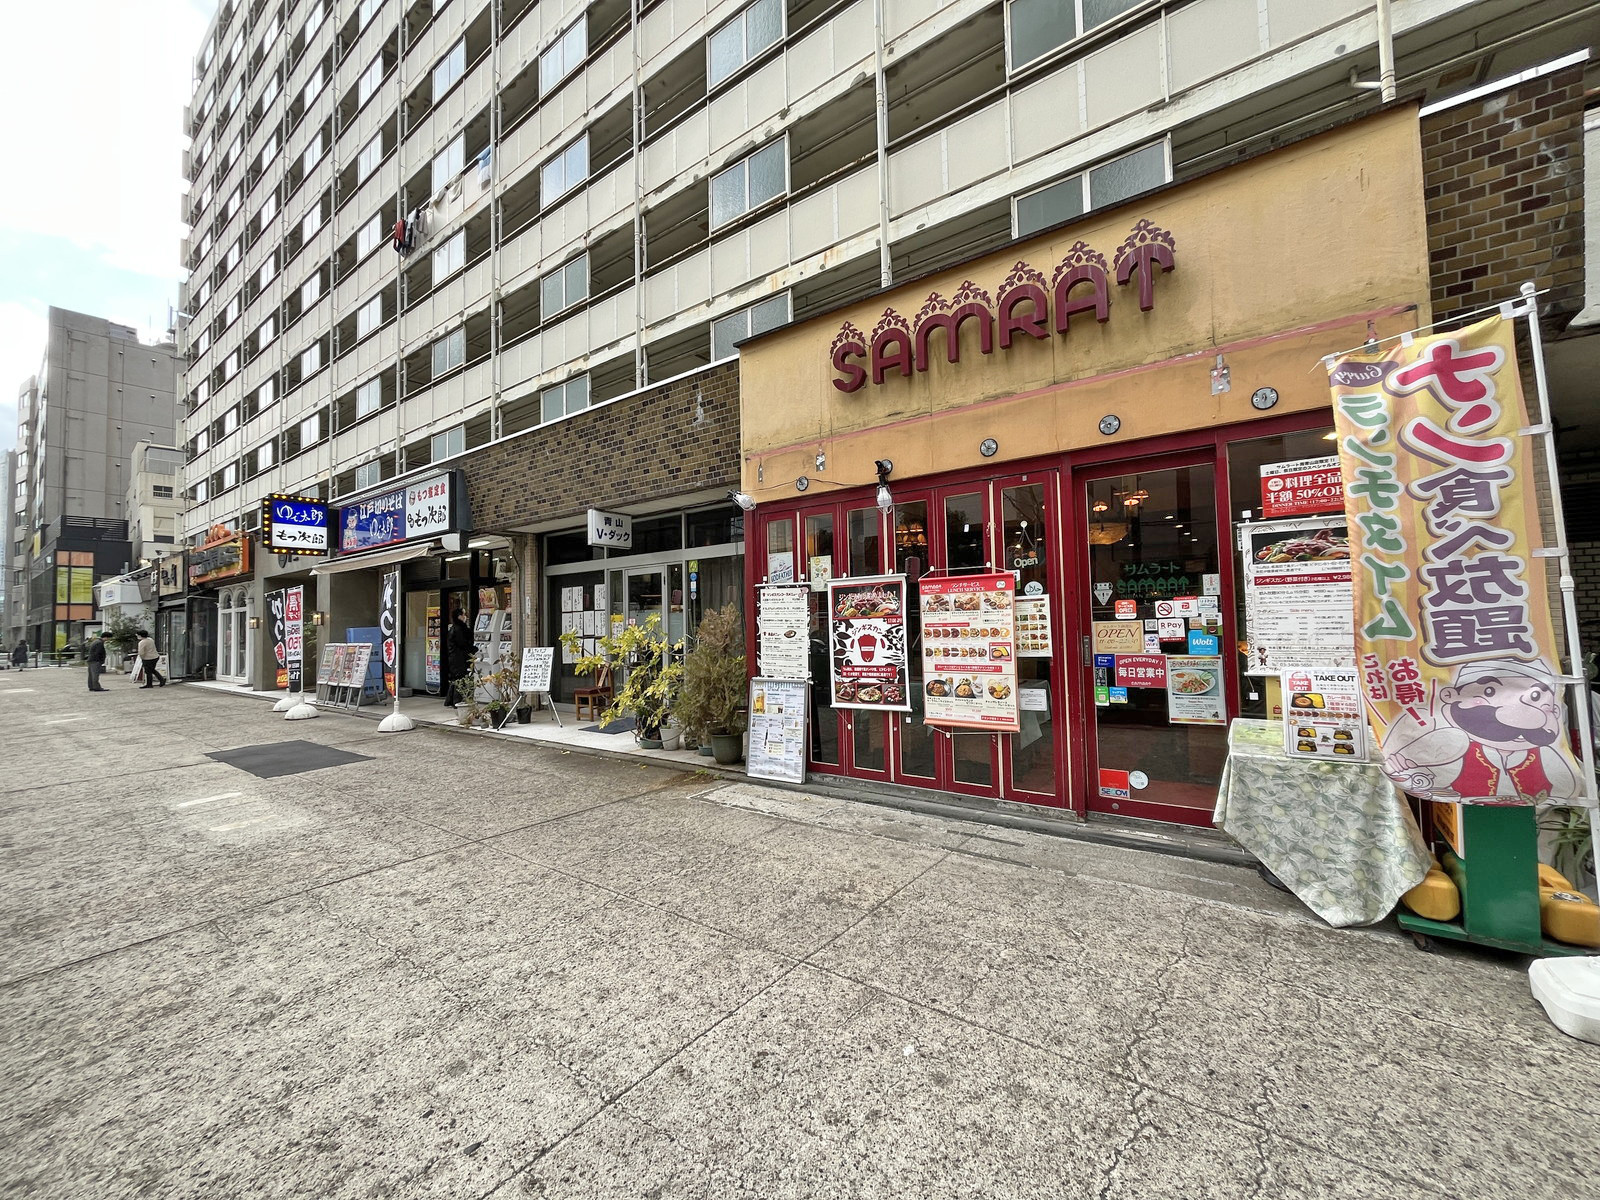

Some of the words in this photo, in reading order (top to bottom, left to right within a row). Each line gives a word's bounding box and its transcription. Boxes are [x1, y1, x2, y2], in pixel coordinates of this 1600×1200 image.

[830, 218, 1176, 393] SAMRAT
[1285, 471, 1342, 489] 料理全品
[1265, 489, 1294, 504] 半額
[604, 516, 623, 527] 青山
[276, 529, 324, 544] もつ次郎
[1014, 556, 1039, 568] Open
[1123, 561, 1180, 576] サムラート
[851, 624, 883, 636] ジンギスカン
[1097, 627, 1139, 638] OPEN
[1192, 638, 1214, 646] Wolt
[1118, 667, 1165, 679] 毎日営業中
[1101, 787, 1128, 797] SECOM
